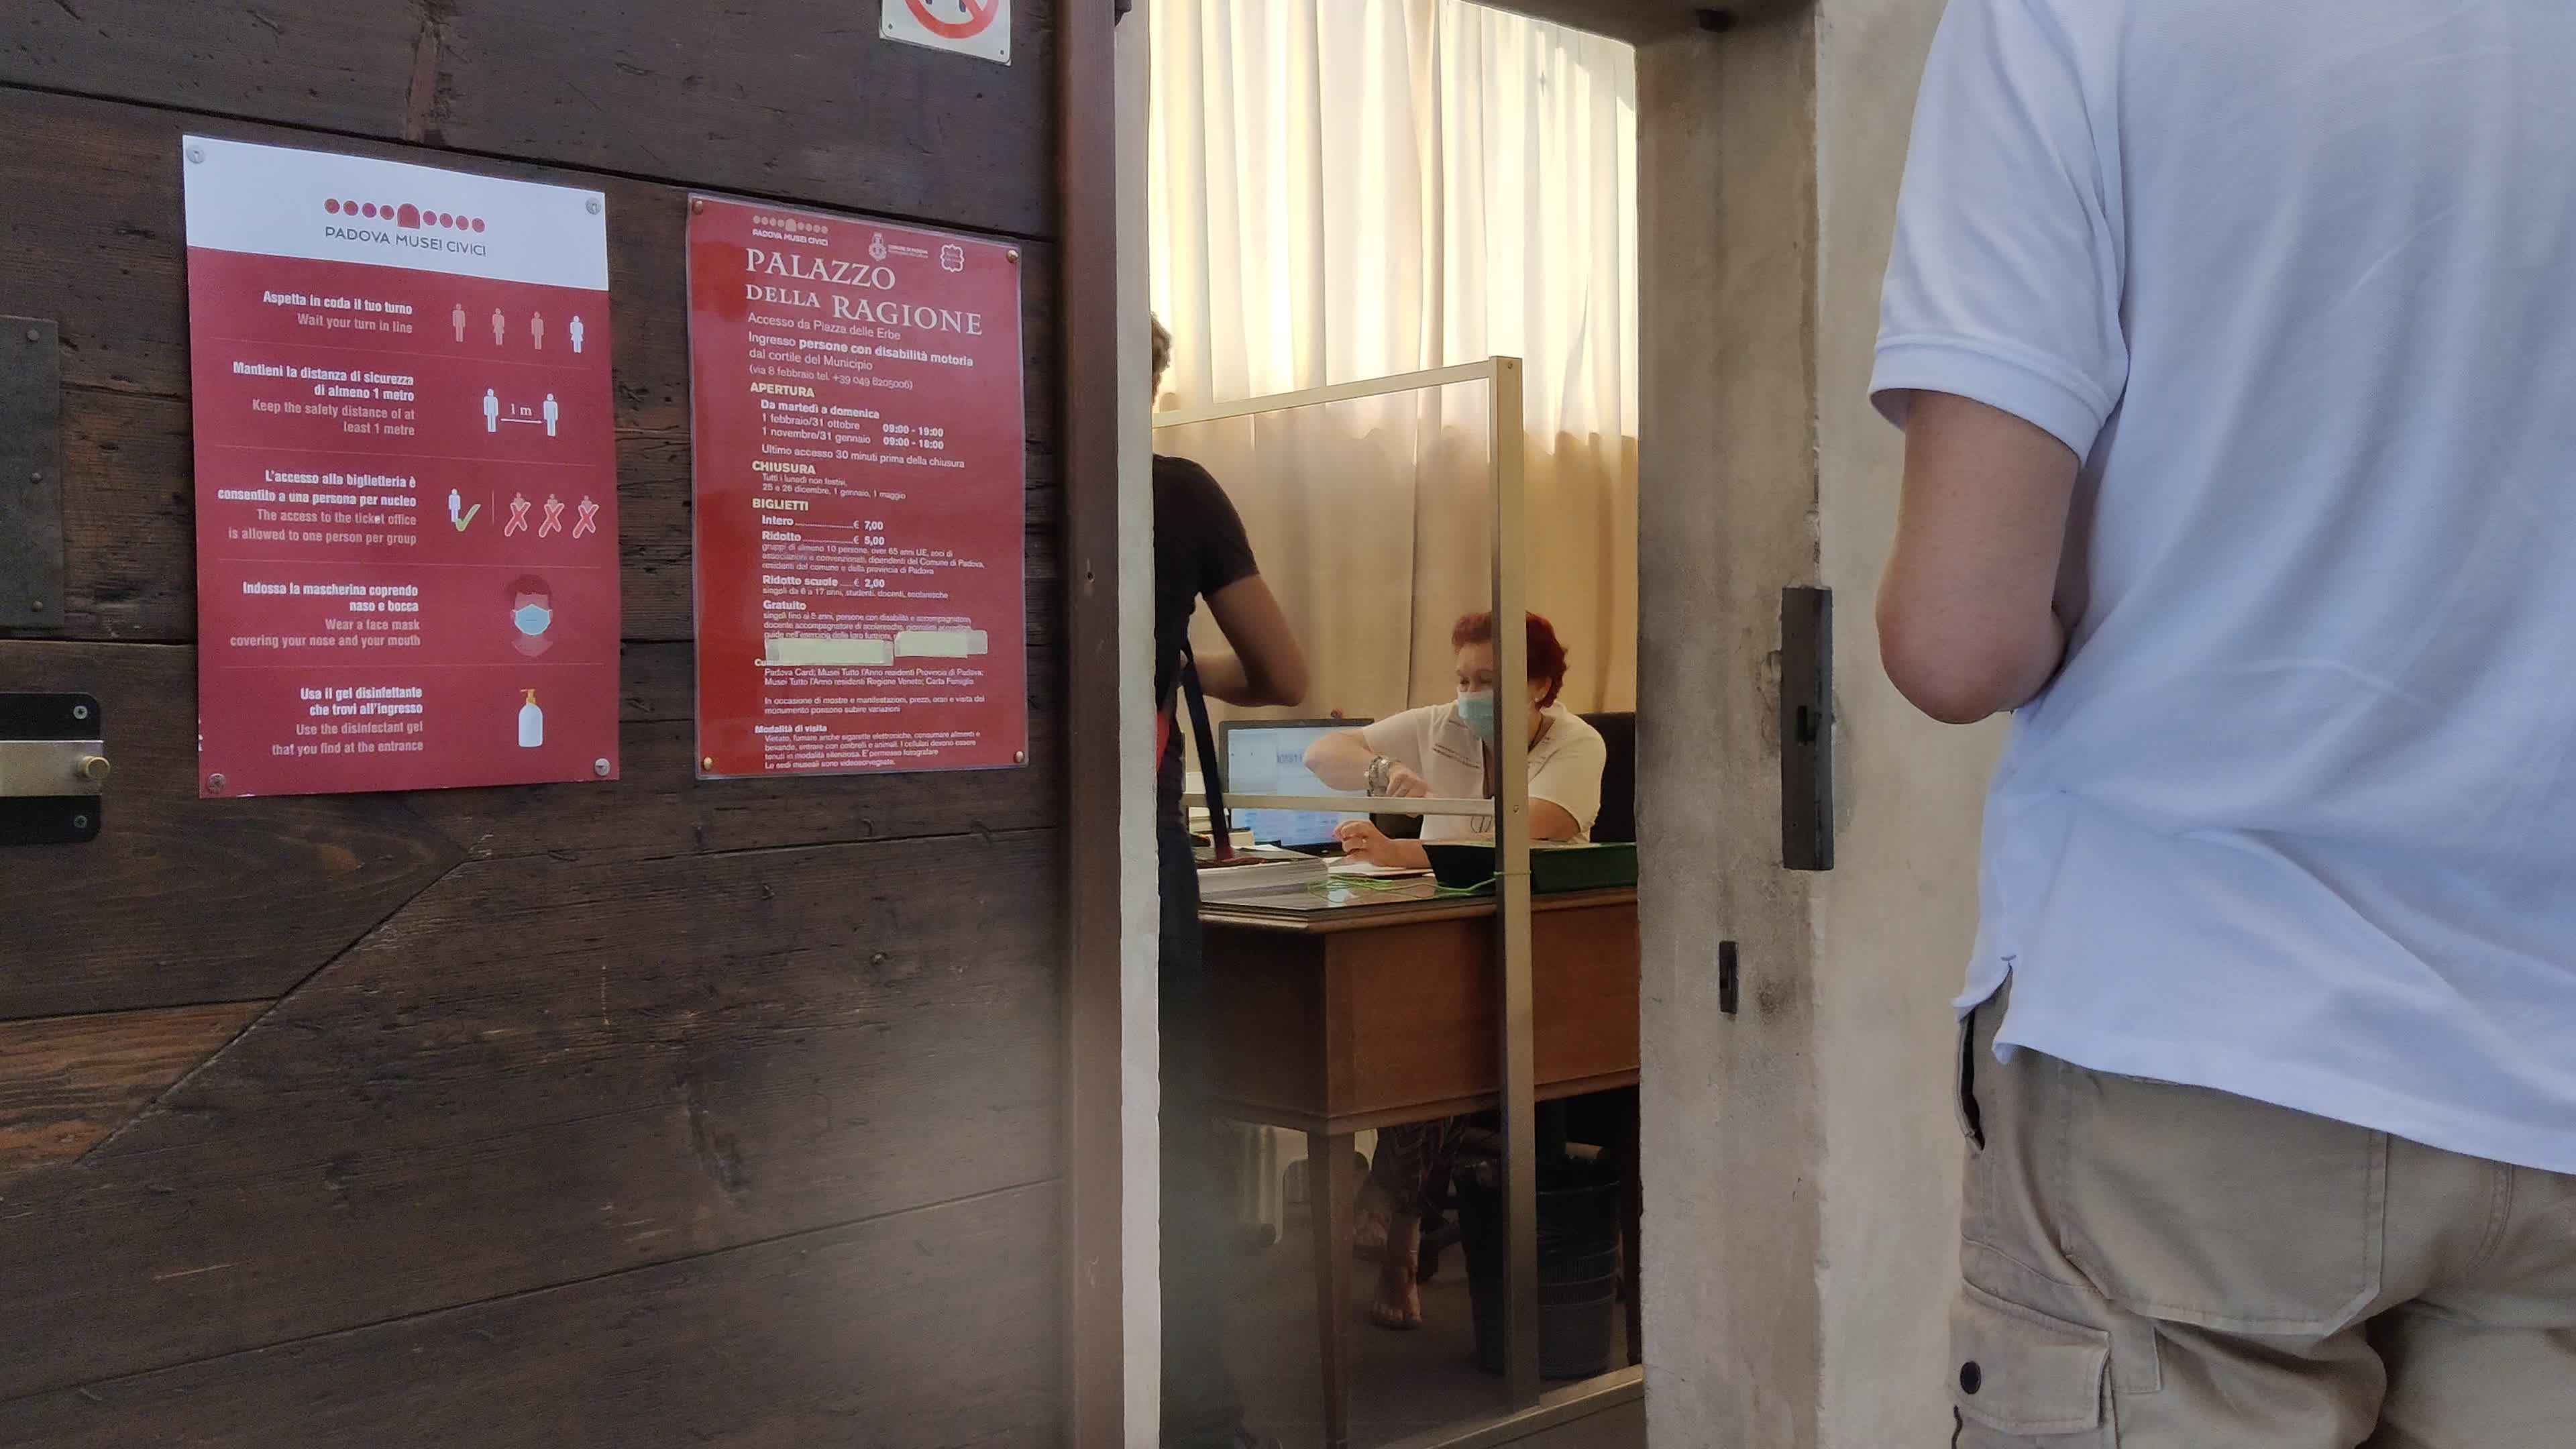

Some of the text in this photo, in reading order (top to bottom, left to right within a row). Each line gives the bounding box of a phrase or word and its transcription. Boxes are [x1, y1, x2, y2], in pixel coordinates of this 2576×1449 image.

[325, 226, 486, 256] PADOVA MUSEI CIVICI
[746, 248, 896, 290] PALAZZO
[263, 290, 412, 315] Aspetta in coda il tuo turno
[746, 284, 982, 335] DELLA RAGIONE
[297, 313, 412, 333] Wait your turn in line
[748, 313, 900, 340] Accesso da Piazza delle Erbe
[749, 331, 973, 366] Ingresso persone con disabilità motoria
[749, 347, 873, 370] dal cortile del Municipio
[233, 362, 413, 385] Mantieni la distanza di sicurezza
[314, 384, 414, 401] di almeno 1 metro
[750, 382, 814, 397] APERTURA
[252, 399, 415, 419] Keep the safety distance of at
[511, 403, 531, 416] 1 m
[761, 399, 775, 409] Da
[778, 402, 818, 413] martedì
[830, 405, 879, 419] domenica
[343, 421, 415, 435] least 1 metre
[762, 413, 766, 421] 1
[827, 419, 860, 429] ottobre
[762, 427, 766, 435] 1
[835, 434, 871, 443] gennaio
[882, 423, 943, 437] 09:00 19:00
[883, 436, 944, 449] 09:00 18:00
[761, 443, 965, 468] Ultimo accesso 30 minuti prima della chiusura
[752, 460, 816, 474] CHIUSURA
[322, 473, 343, 484] alla
[346, 474, 406, 488] biglietteria
[409, 476, 415, 488] è
[217, 489, 416, 506] consentito a una persona per nucleo
[752, 498, 808, 511] BIGLIETTI
[257, 508, 416, 525] The access to the ticket office
[864, 521, 883, 531] 7,00
[228, 527, 416, 545] is allowed to one person per group
[864, 535, 884, 546] 5,00
[243, 582, 418, 598] Indossa la mascherina coprendo
[762, 575, 885, 589] Ridotto scuole 2,00
[350, 600, 419, 612] naso e bocca
[763, 600, 806, 610] Gratuito
[325, 619, 420, 631] Wear a face mask
[230, 635, 420, 649] covering your nose and your mouth
[301, 686, 422, 701] Usa il gel disinfettante
[310, 704, 329, 716] che
[332, 702, 357, 715] trovi
[296, 720, 423, 735] Use the disinfectant gel
[272, 741, 423, 757] that you find at the entrance
